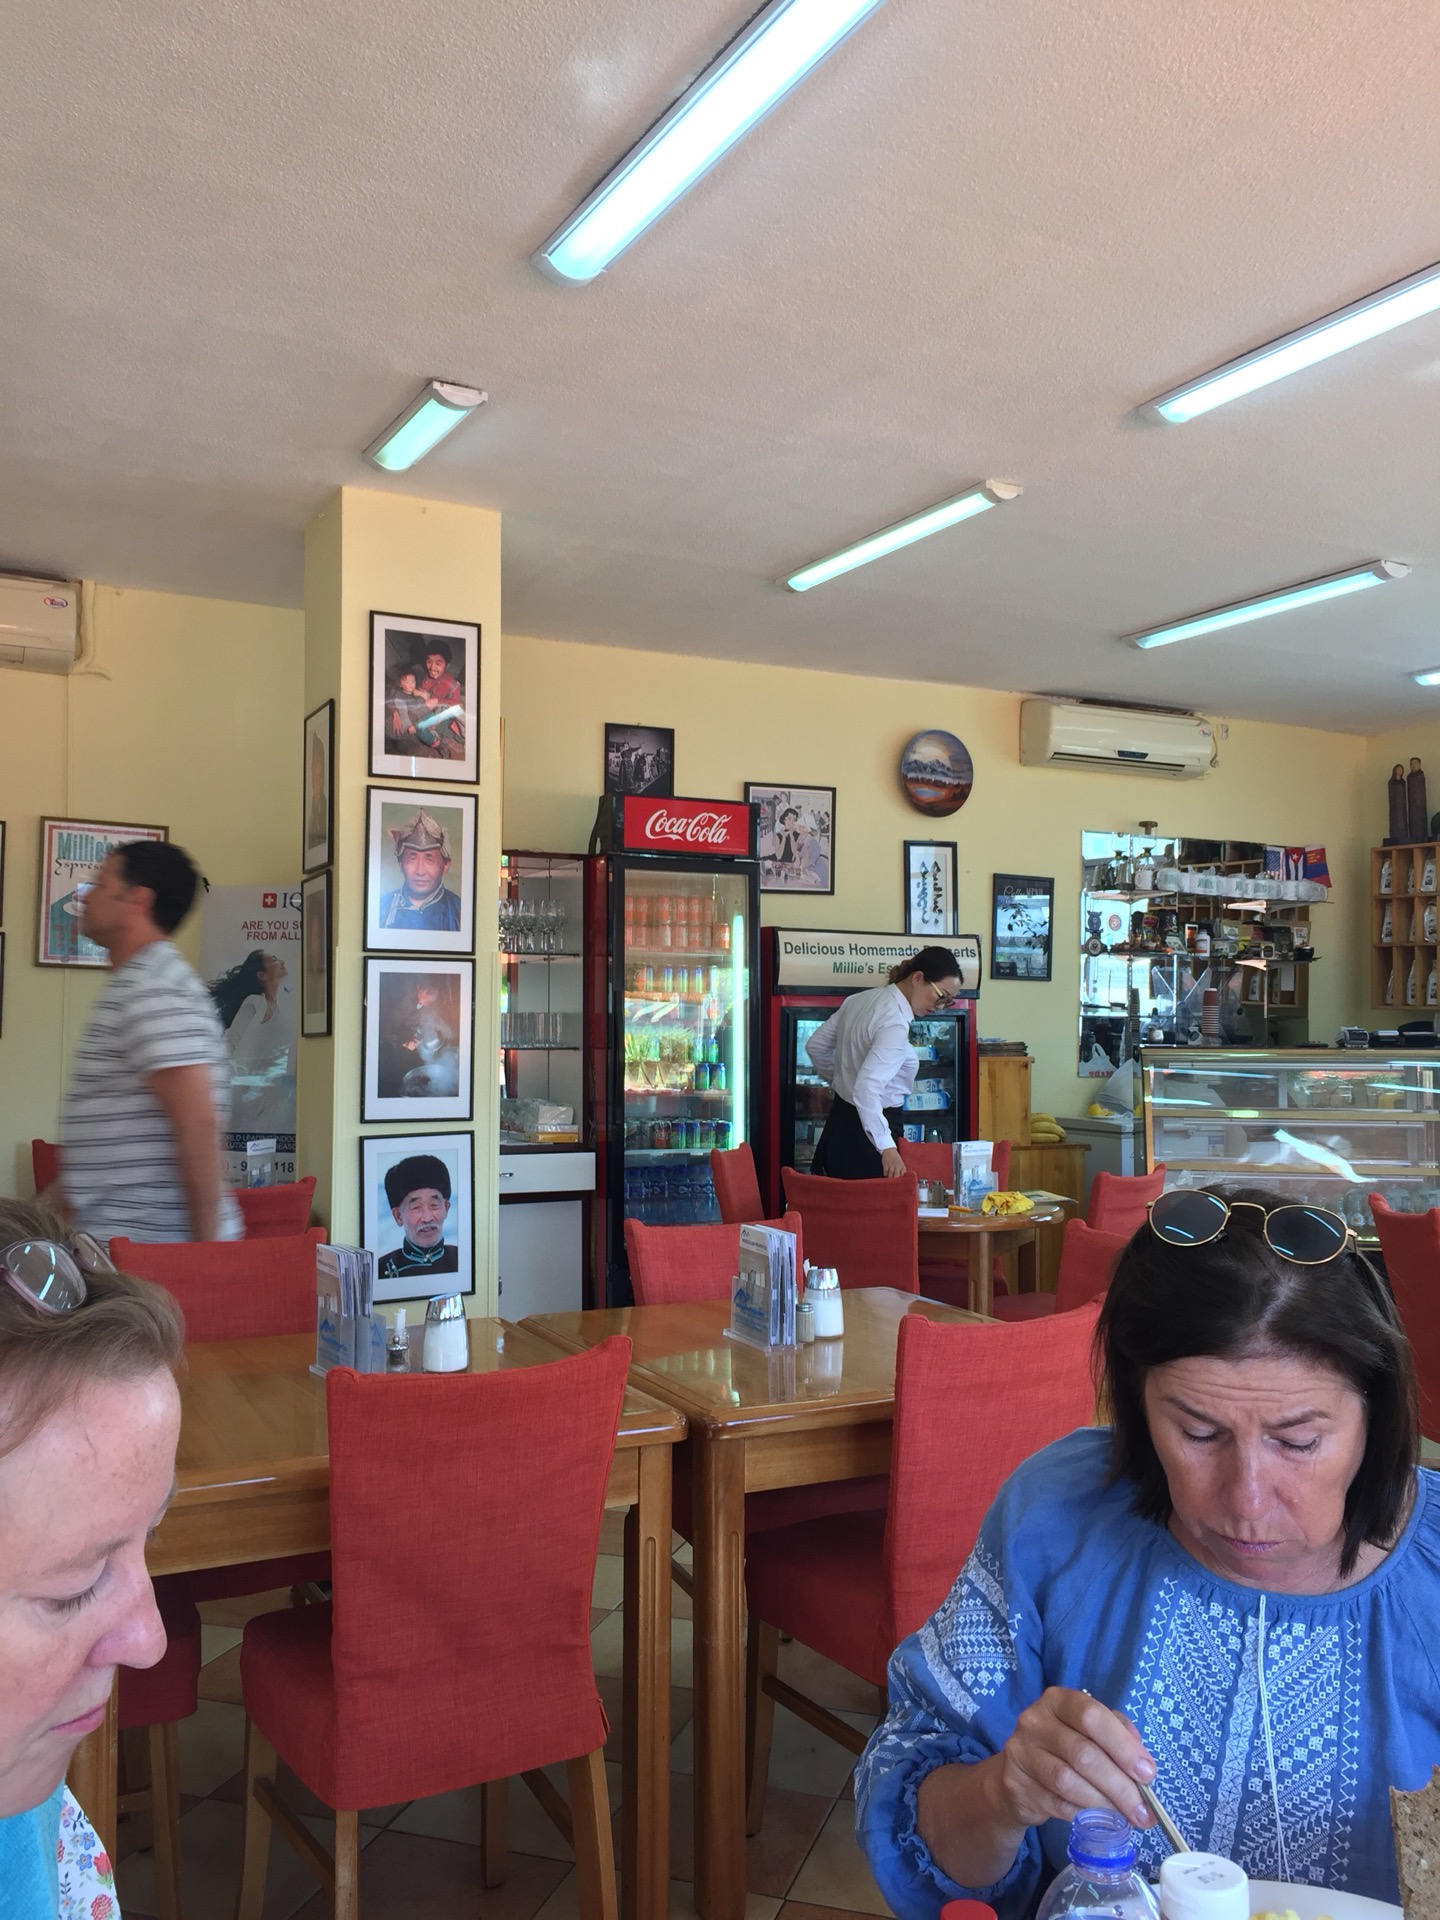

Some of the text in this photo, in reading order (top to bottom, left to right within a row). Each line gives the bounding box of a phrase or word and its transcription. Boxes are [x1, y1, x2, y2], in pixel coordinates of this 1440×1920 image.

[645, 809, 732, 844] Coca-Cola
[282, 892, 302, 912] IQ
[241, 921, 263, 930] ARE
[267, 921, 289, 930] YOU
[247, 931, 300, 941] FROM ALL
[784, 942, 845, 955] Delicious
[848, 943, 919, 957] Homemade
[832, 962, 874, 974] Millie's
[275, 1135, 296, 1143] INDOO
